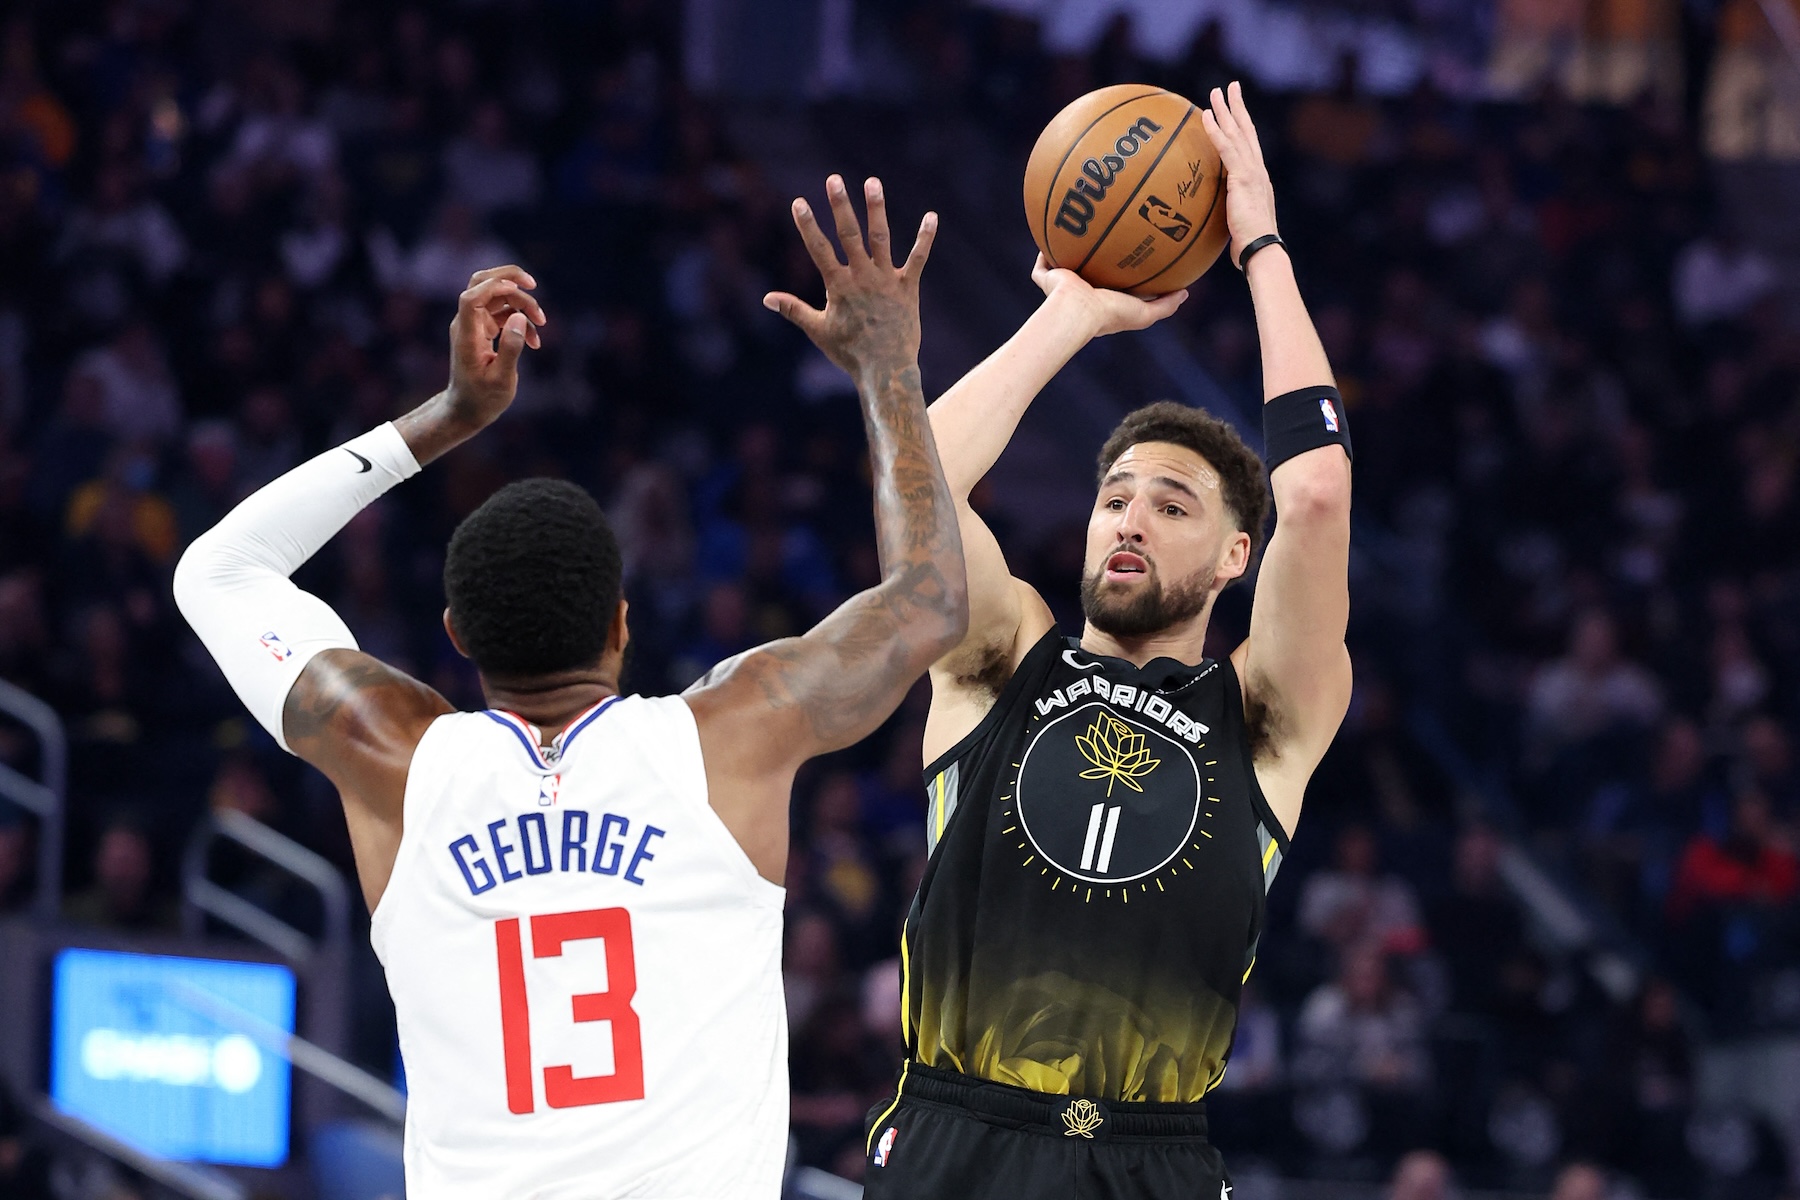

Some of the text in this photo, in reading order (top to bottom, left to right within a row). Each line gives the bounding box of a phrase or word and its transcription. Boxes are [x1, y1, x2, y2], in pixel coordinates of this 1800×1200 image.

[1054, 117, 1163, 237] Wilson
[1035, 675, 1209, 743] WARRIORS
[449, 810, 666, 895] GEORGE
[1080, 803, 1121, 873] 11
[495, 907, 645, 1115] 13
